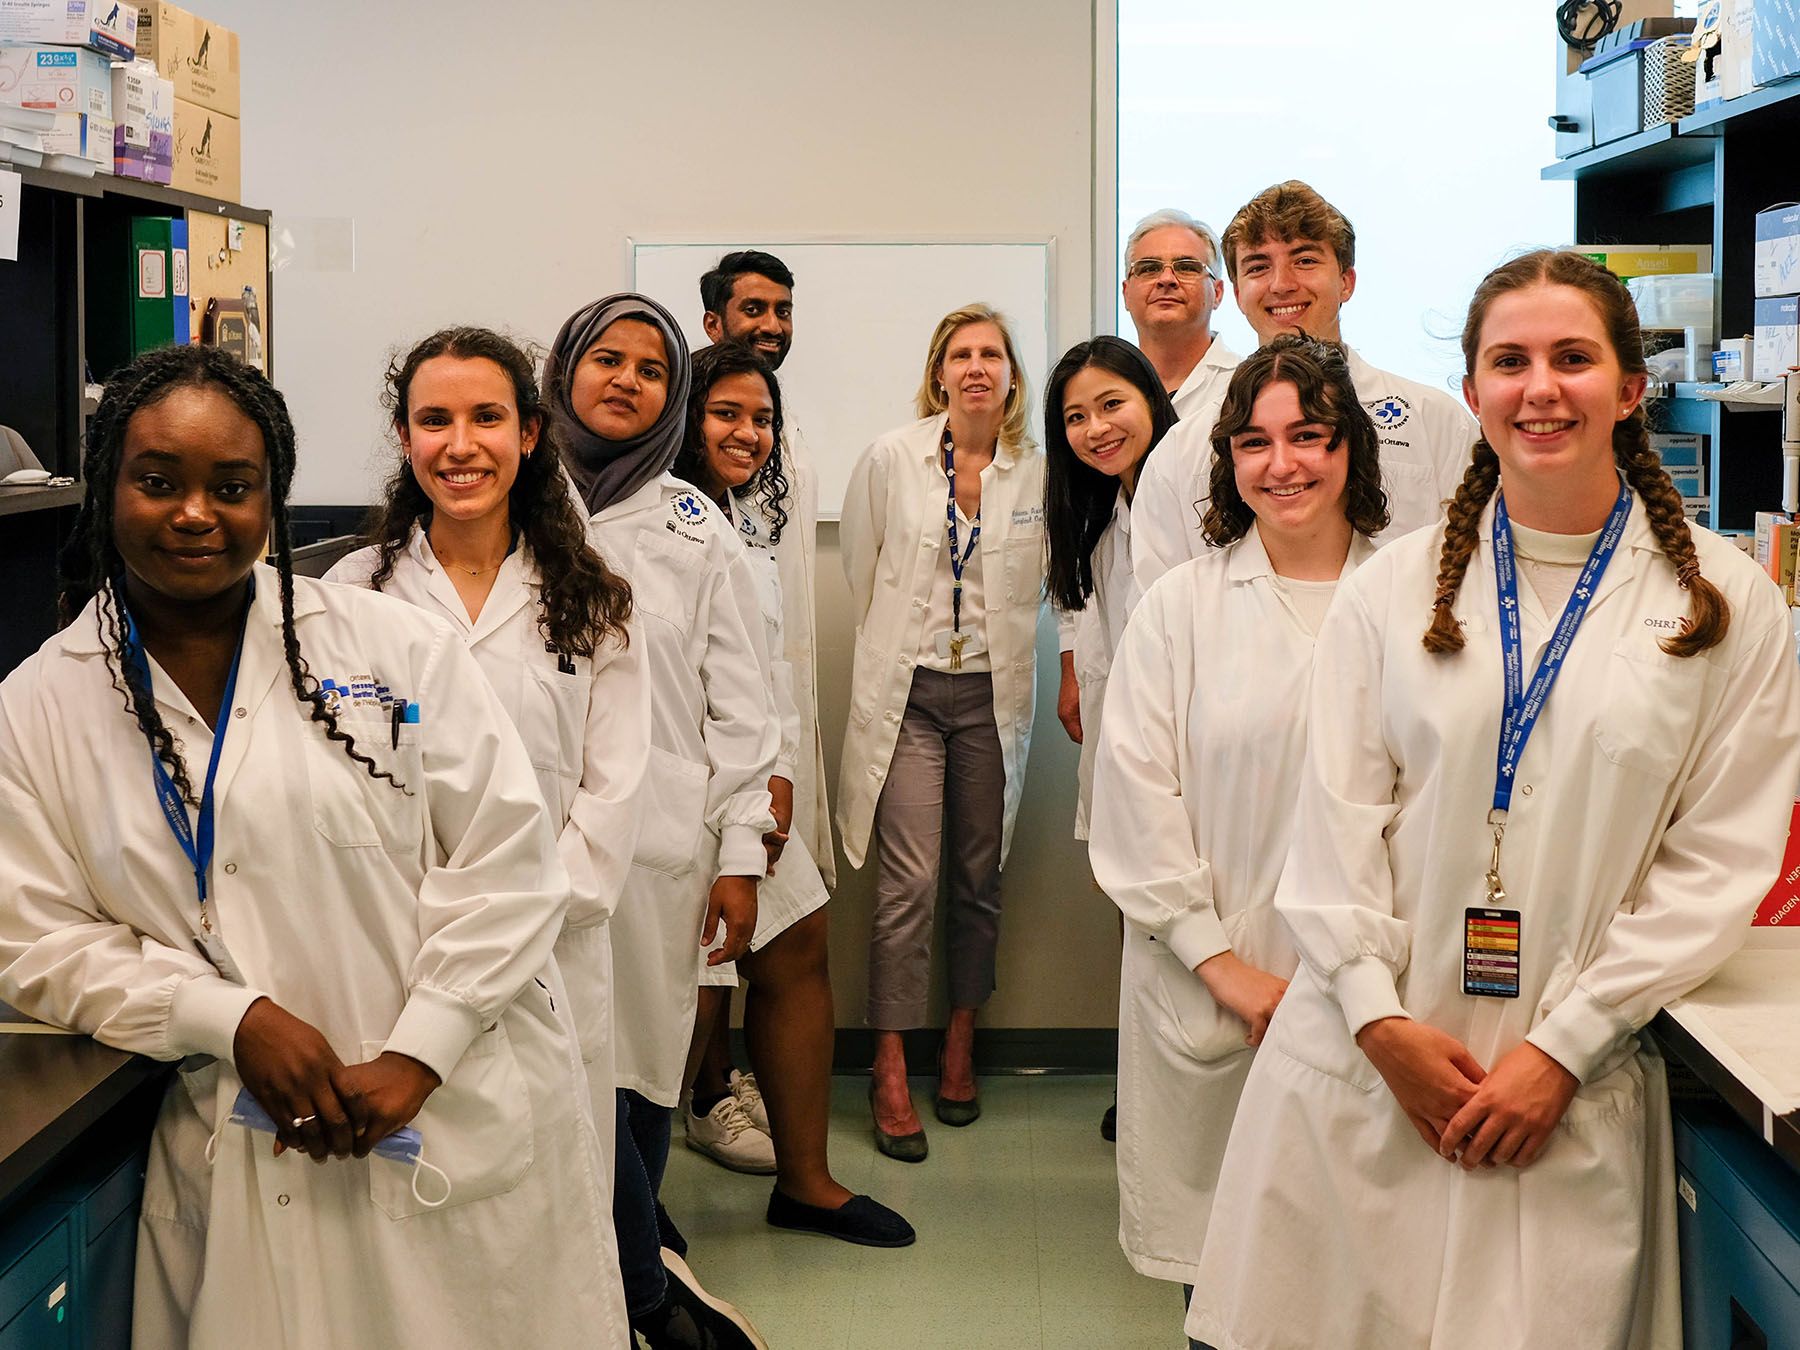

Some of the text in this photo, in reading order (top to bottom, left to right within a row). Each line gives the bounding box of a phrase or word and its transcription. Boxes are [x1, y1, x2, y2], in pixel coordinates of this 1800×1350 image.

[41, 53, 53, 65] 23
[1671, 468, 1699, 476] eppendorf
[1644, 618, 1676, 629] OHRI
[1518, 703, 1532, 727] Inspired
[1528, 701, 1539, 720] Driven
[1769, 894, 1800, 926] QIAGEN
